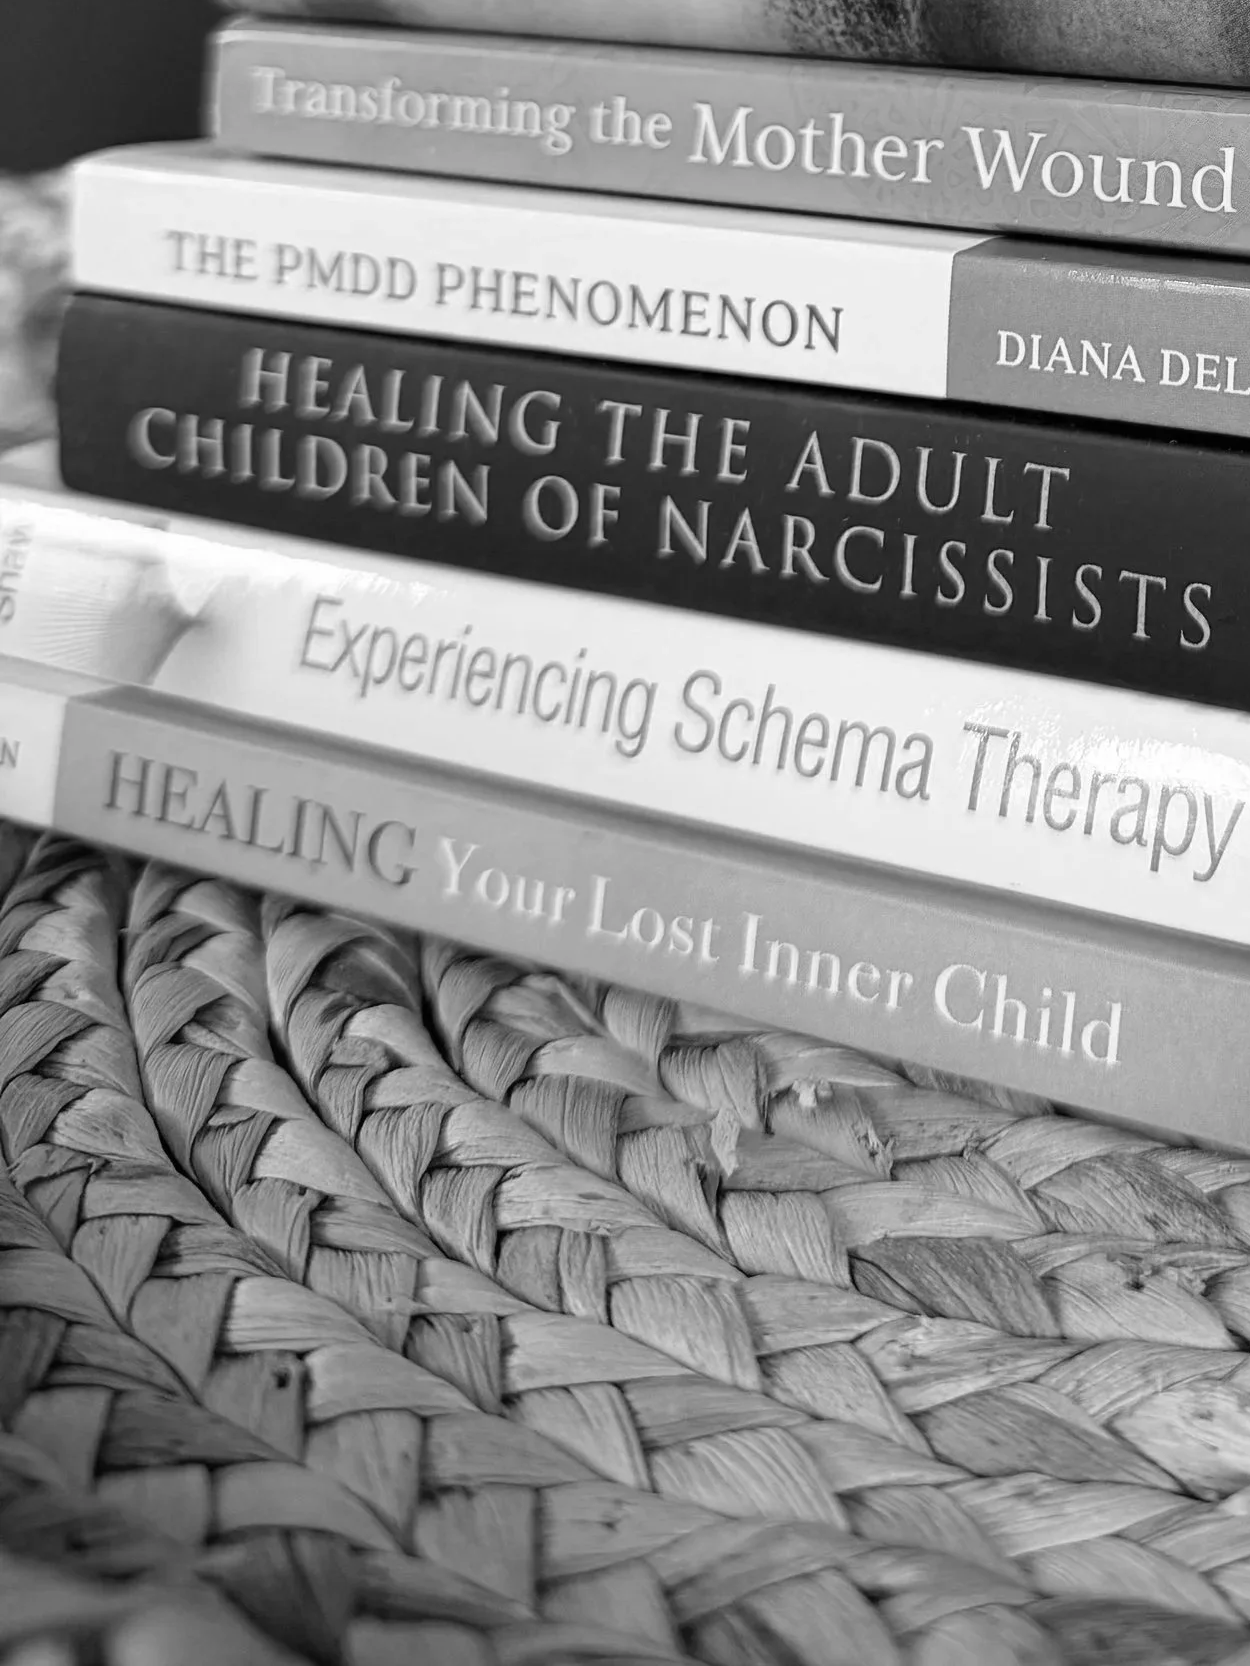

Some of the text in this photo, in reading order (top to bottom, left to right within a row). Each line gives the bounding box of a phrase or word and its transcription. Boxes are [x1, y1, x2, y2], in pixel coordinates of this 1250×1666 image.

[248, 65, 1237, 214] Transforming the Mother Wound
[168, 230, 846, 354] THE PMDD PHENOMENON
[996, 330, 1146, 384] DIANA
[127, 407, 1214, 650] CHILDREN OF NARCISSISTS
[237, 346, 1070, 531] HEALING THE ADULT
[298, 594, 659, 758] Experiencing
[673, 669, 935, 802] Schema
[963, 721, 1245, 882] Therapy
[103, 750, 1123, 1067] HEALING Your Lost Inner Child
